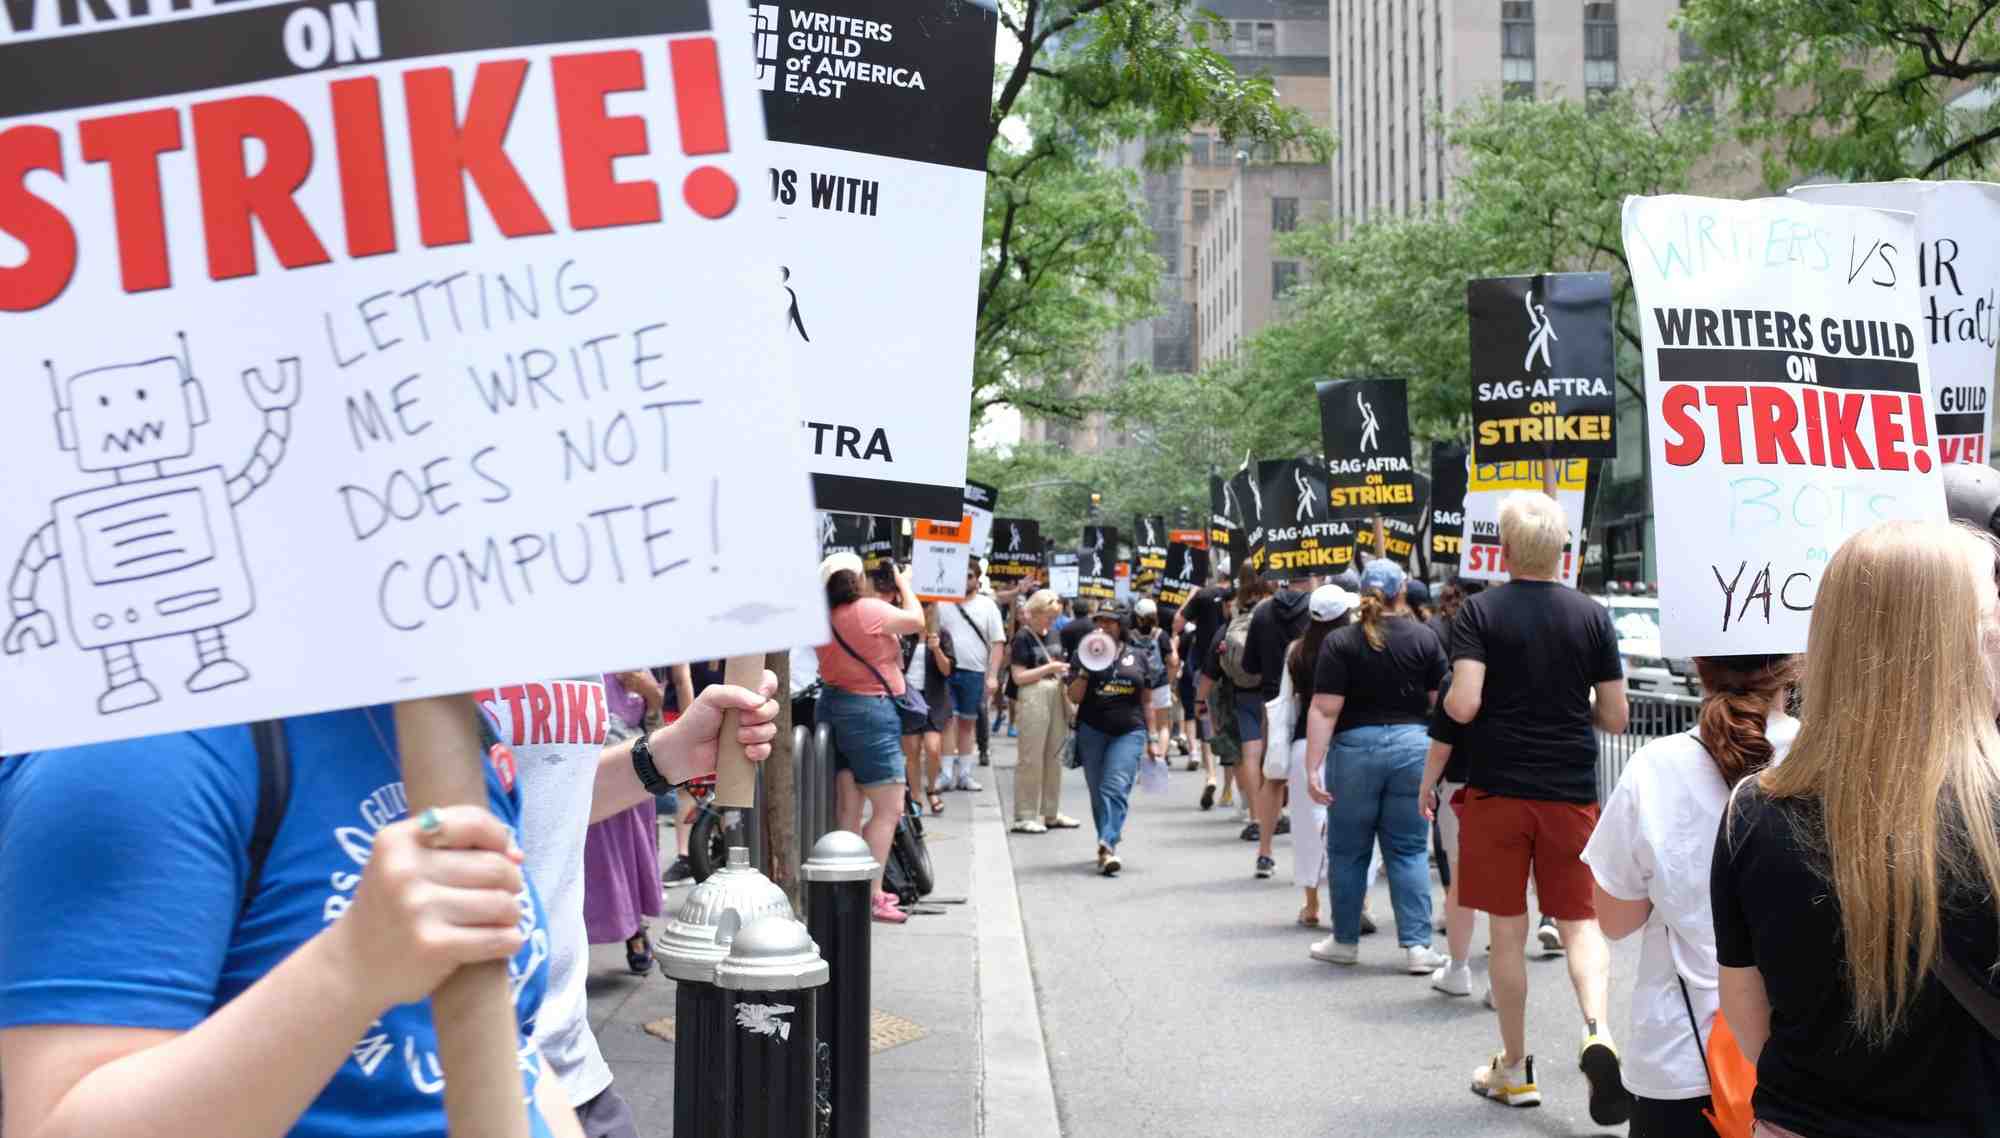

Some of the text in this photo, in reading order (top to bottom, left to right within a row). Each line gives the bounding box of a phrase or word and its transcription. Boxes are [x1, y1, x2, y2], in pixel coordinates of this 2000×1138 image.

[283, 0, 381, 69] ON
[789, 9, 893, 42] WRITERS
[787, 31, 861, 58] GUILD
[784, 73, 847, 99] EAST
[785, 55, 926, 91] of AMERICA
[0, 37, 739, 313] STRIKE!
[810, 172, 879, 216] WITH
[1632, 208, 1899, 289] WRITERS VS
[325, 259, 598, 368] LETTING
[1653, 307, 1915, 360] WRITERS GUILD
[345, 322, 668, 452] ME WRITE
[1786, 354, 1818, 384] ON
[1529, 401, 1557, 416] ON
[1940, 385, 1987, 413] GUILD
[802, 420, 894, 463] TRA
[1478, 415, 1612, 446] STRIKE!
[1661, 383, 1933, 475] STRIKE!
[338, 399, 703, 541] DOES NOT
[1365, 474, 1384, 485] ON
[1331, 483, 1414, 507] STRIKE!
[379, 476, 721, 632] COMPUTE!
[1268, 545, 1354, 571] STRIKE!
[1300, 539, 1319, 550] ON
[1356, 530, 1412, 557] STKE!
[1711, 560, 1815, 632] YAC
